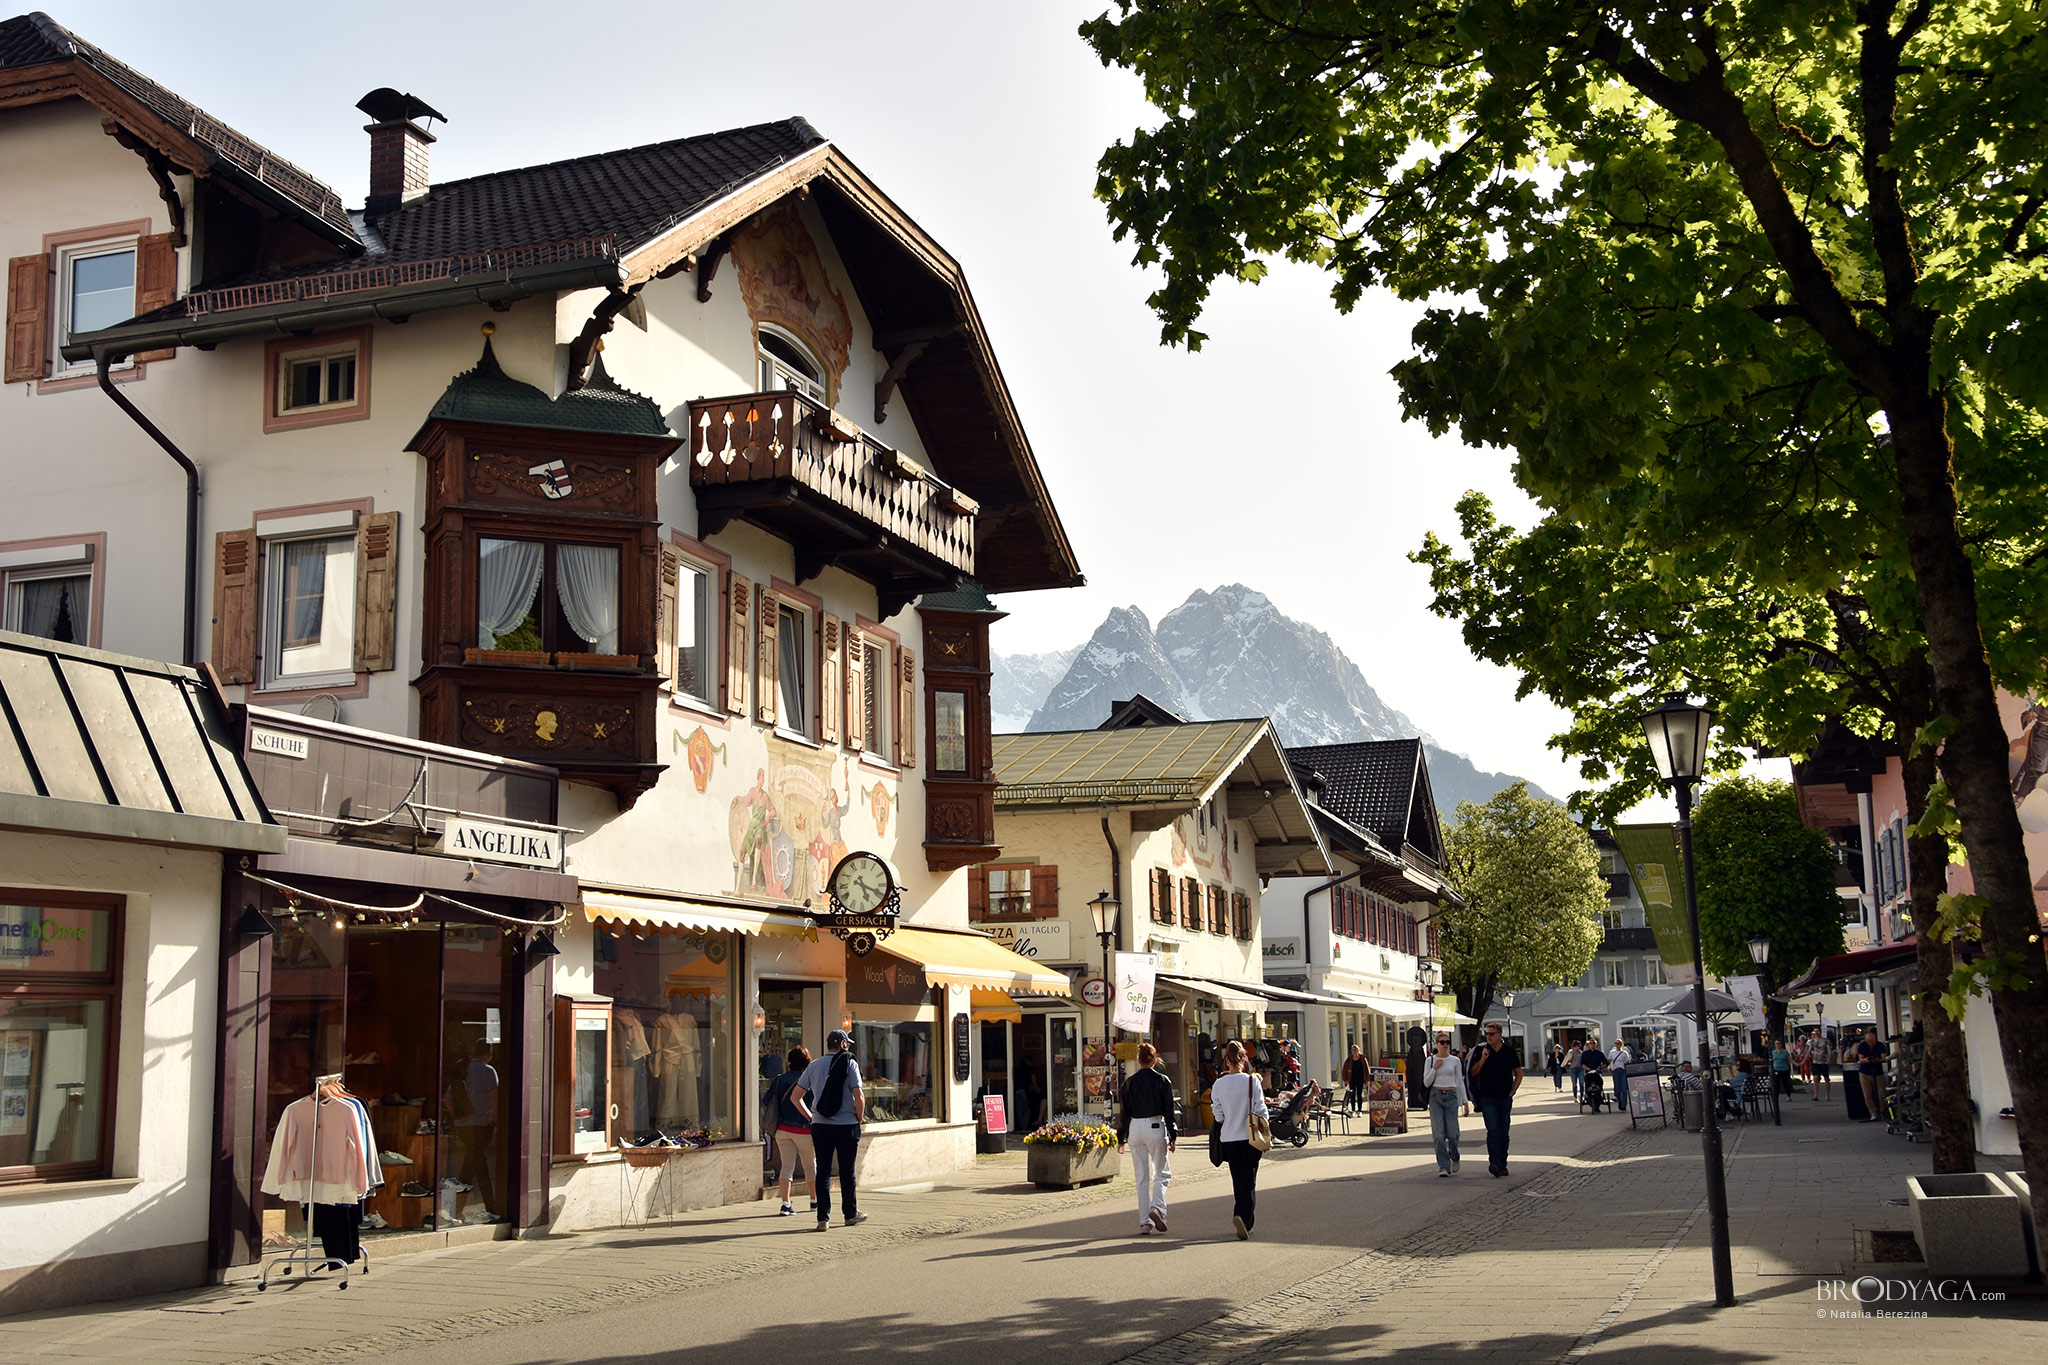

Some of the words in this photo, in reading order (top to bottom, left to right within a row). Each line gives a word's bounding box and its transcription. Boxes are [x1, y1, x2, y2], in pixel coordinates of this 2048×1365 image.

[256, 733, 305, 753] SCHUHE
[453, 827, 552, 860] ANGELIKA
[835, 916, 887, 926] GERSPACH
[1031, 926, 1060, 934] TAGLIO
[1127, 991, 1147, 1003] GoPa
